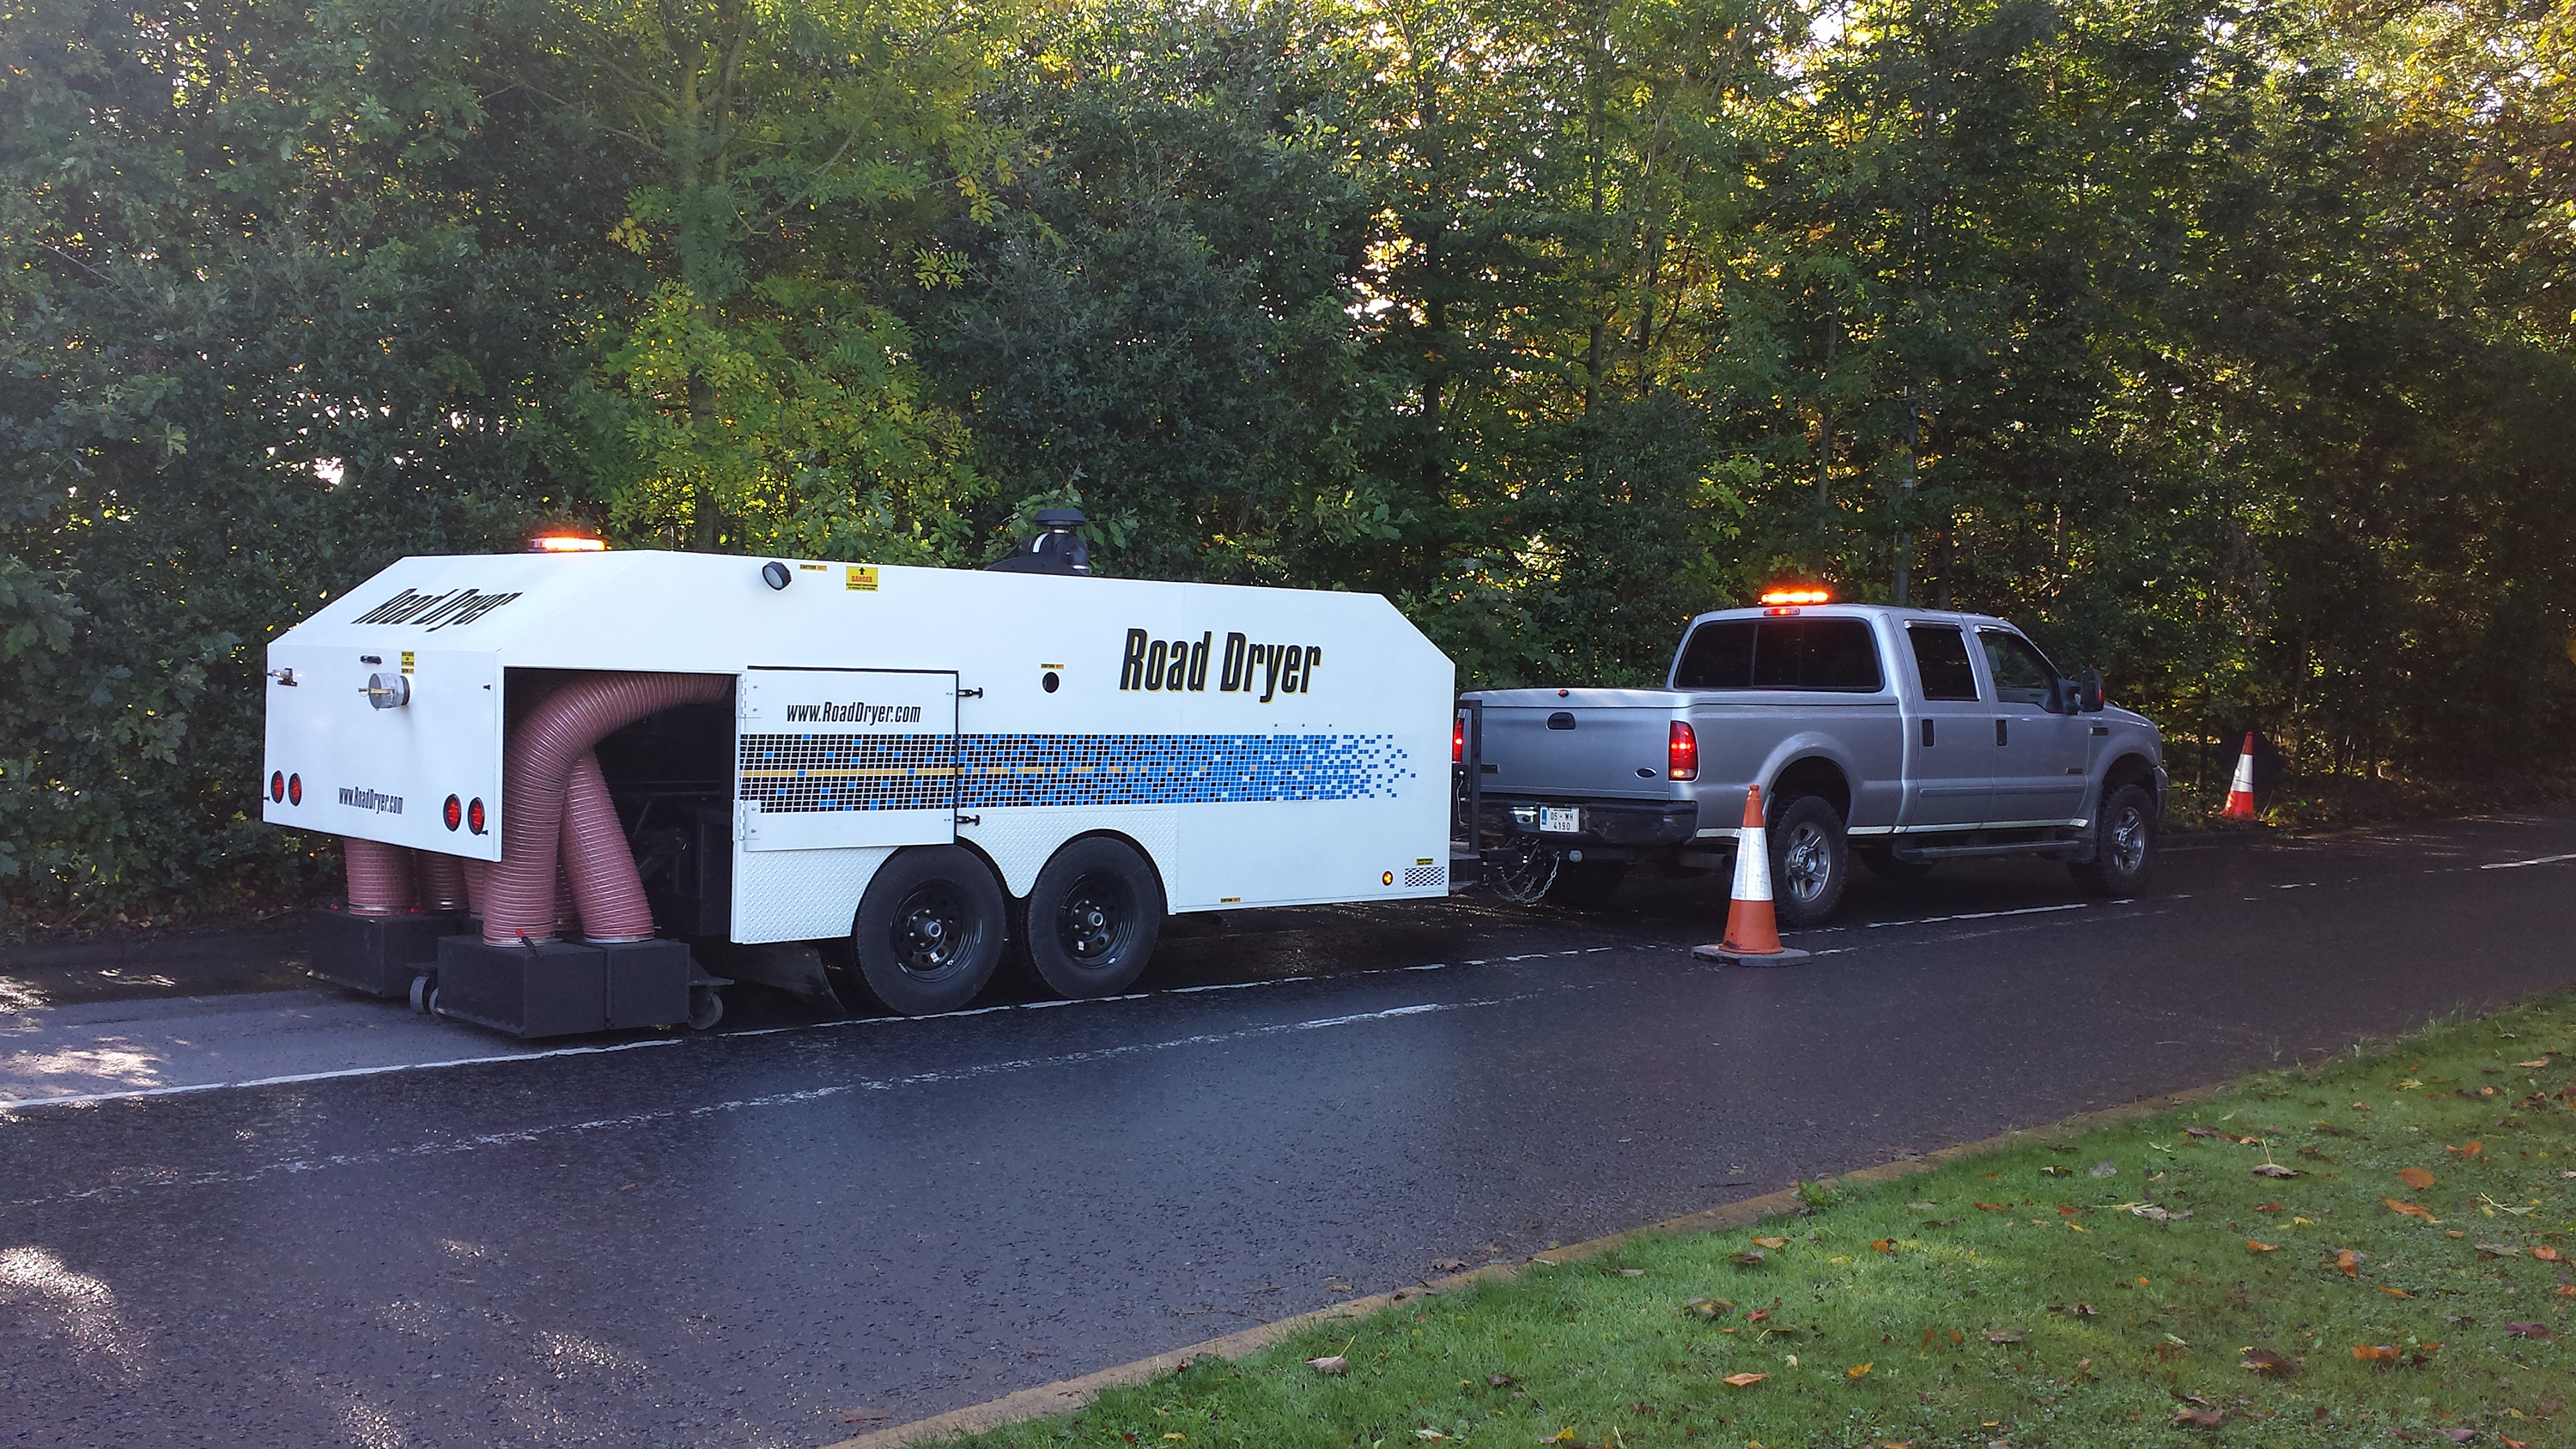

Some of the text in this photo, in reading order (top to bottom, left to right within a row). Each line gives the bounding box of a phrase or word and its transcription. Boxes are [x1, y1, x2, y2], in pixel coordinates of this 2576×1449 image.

[350, 587, 524, 633] Road Dryer
[1119, 627, 1322, 705] Road Dryer
[787, 701, 921, 726] www.RoadDryer.com
[338, 785, 404, 815] www.RoadDryer.com
[1553, 822, 1571, 831] 4190
